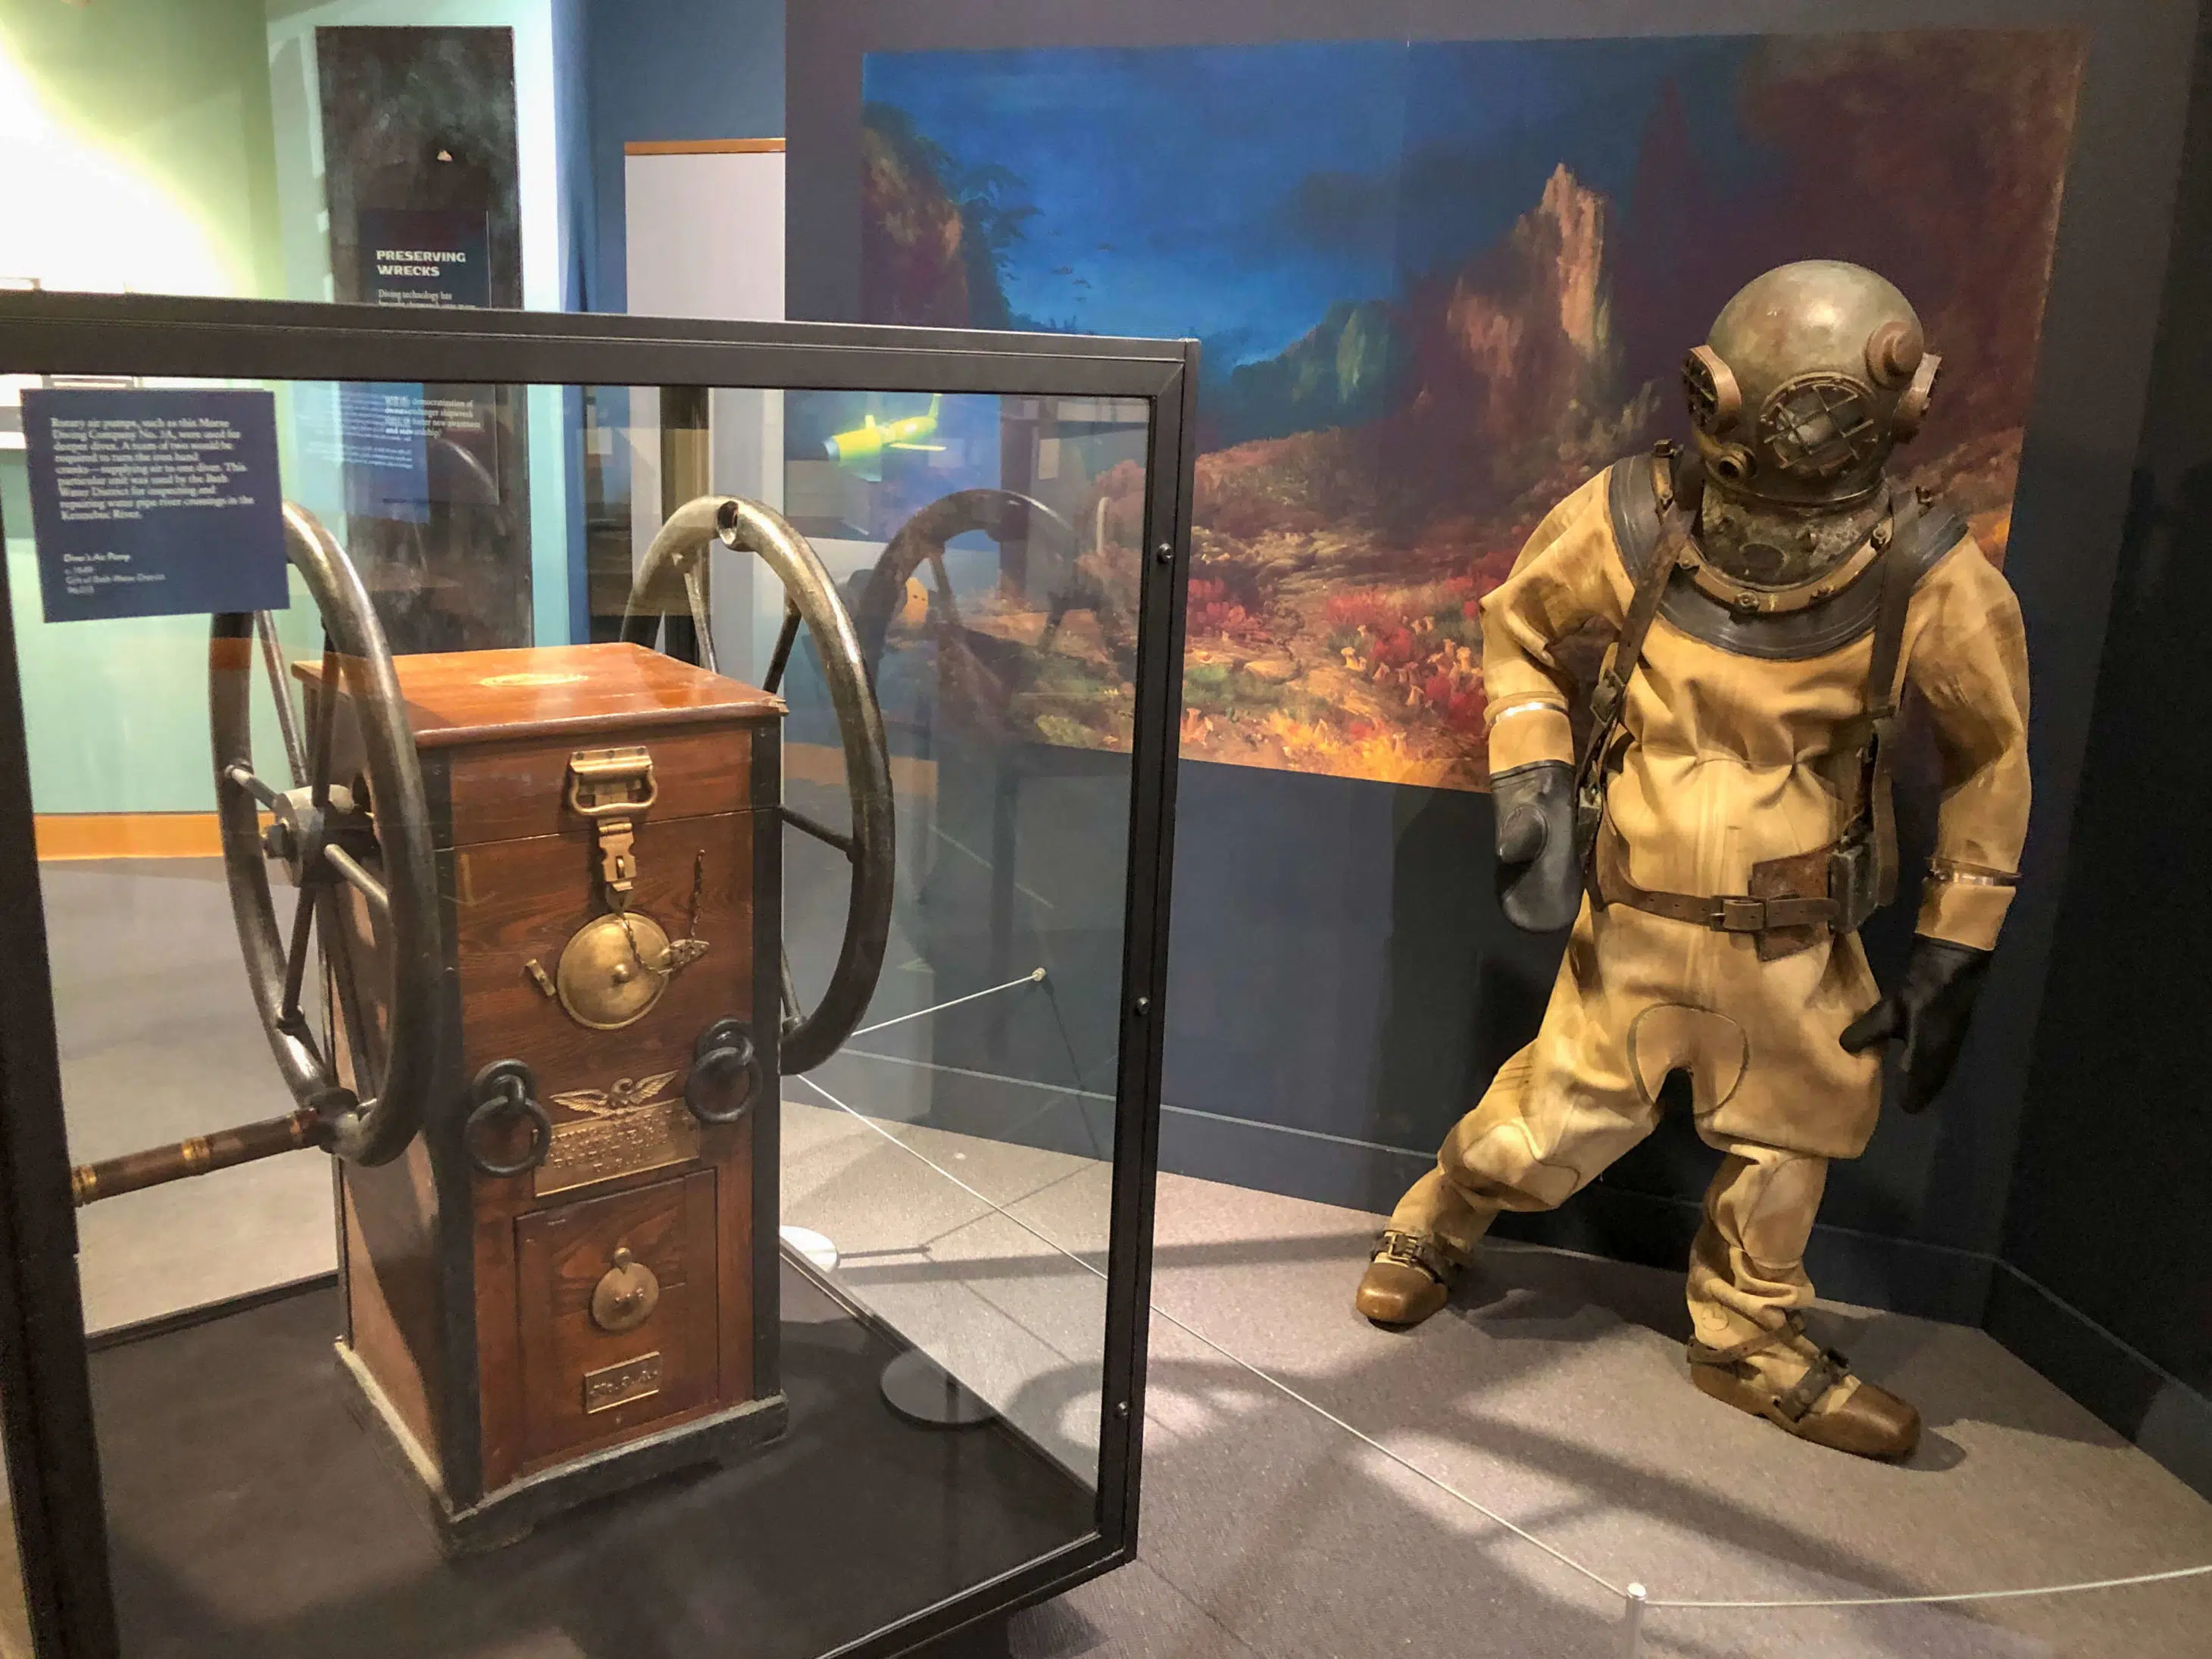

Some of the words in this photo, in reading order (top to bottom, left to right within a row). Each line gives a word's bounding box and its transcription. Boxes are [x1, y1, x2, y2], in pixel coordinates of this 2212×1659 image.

[376, 250, 466, 262] PRESERVING
[377, 265, 440, 276] WRECKS
[378, 289, 401, 301] Diving
[403, 289, 439, 301] technology
